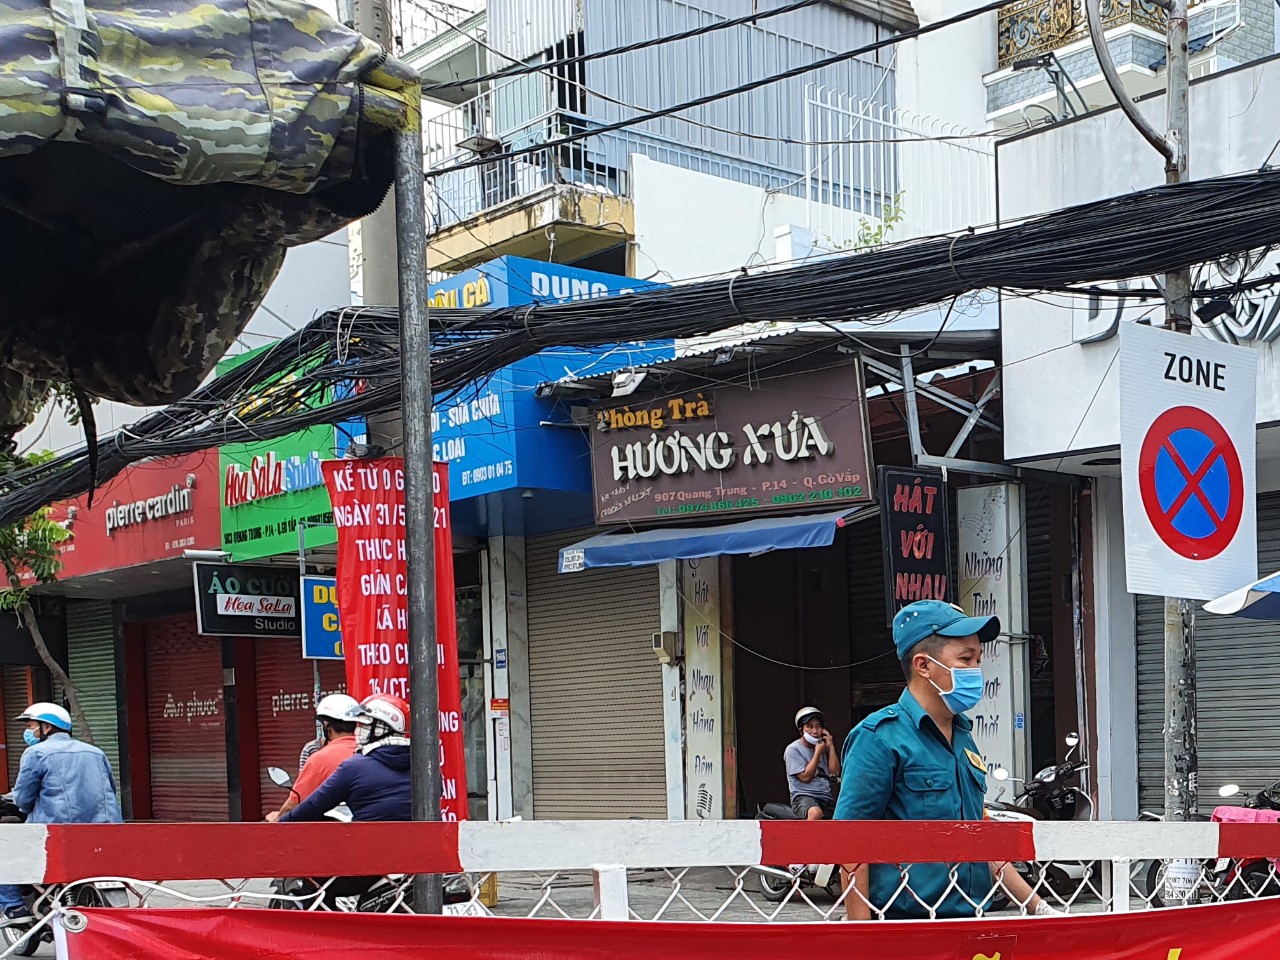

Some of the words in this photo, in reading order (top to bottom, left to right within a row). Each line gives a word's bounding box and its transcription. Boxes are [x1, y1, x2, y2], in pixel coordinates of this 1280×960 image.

[1164, 352, 1226, 391] ZONE
[668, 393, 710, 421] Trà
[611, 430, 733, 481] HƯƠNG
[742, 410, 830, 466] XƯA
[357, 463, 379, 490] TỪ
[676, 488, 711, 500] Quang
[715, 485, 747, 497] Trung
[894, 478, 937, 515] HÁT
[105, 500, 144, 536] pierre
[146, 484, 192, 520] cardin
[176, 516, 194, 527] PARIS
[333, 499, 371, 528] NGÀY
[901, 524, 935, 559] VỚI
[895, 572, 946, 600] NHAU
[224, 596, 254, 613] Hoa
[255, 618, 296, 631] Studio
